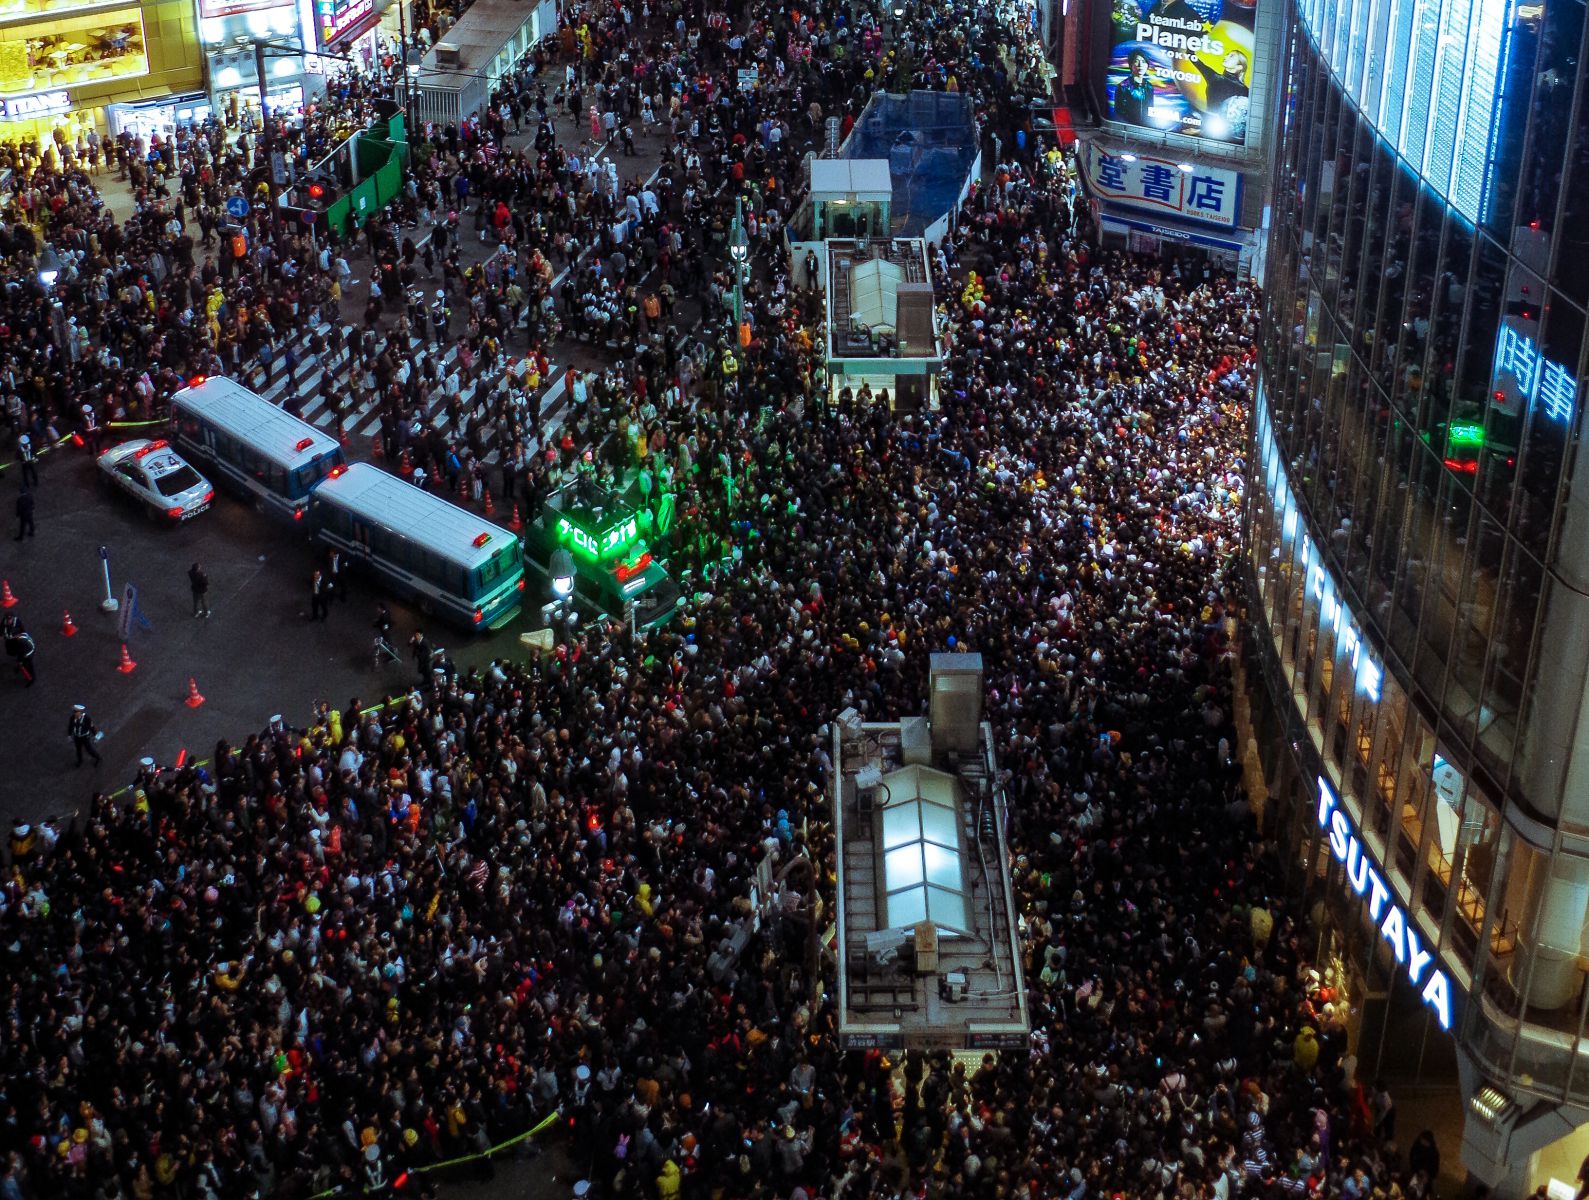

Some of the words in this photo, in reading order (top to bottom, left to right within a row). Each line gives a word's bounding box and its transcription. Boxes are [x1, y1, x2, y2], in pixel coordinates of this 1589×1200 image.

[1149, 12, 1202, 32] teamLab
[1136, 22, 1224, 56] Planets
[1160, 49, 1199, 62] TOKYO
[1154, 66, 1202, 84] TOYOSU
[1096, 155, 1225, 213] 堂書店
[1206, 210, 1231, 224] TAISEIDO
[1151, 226, 1190, 239] TAISEIDO
[181, 503, 211, 521] POLICE
[1317, 775, 1452, 1031] TSUTAYA
